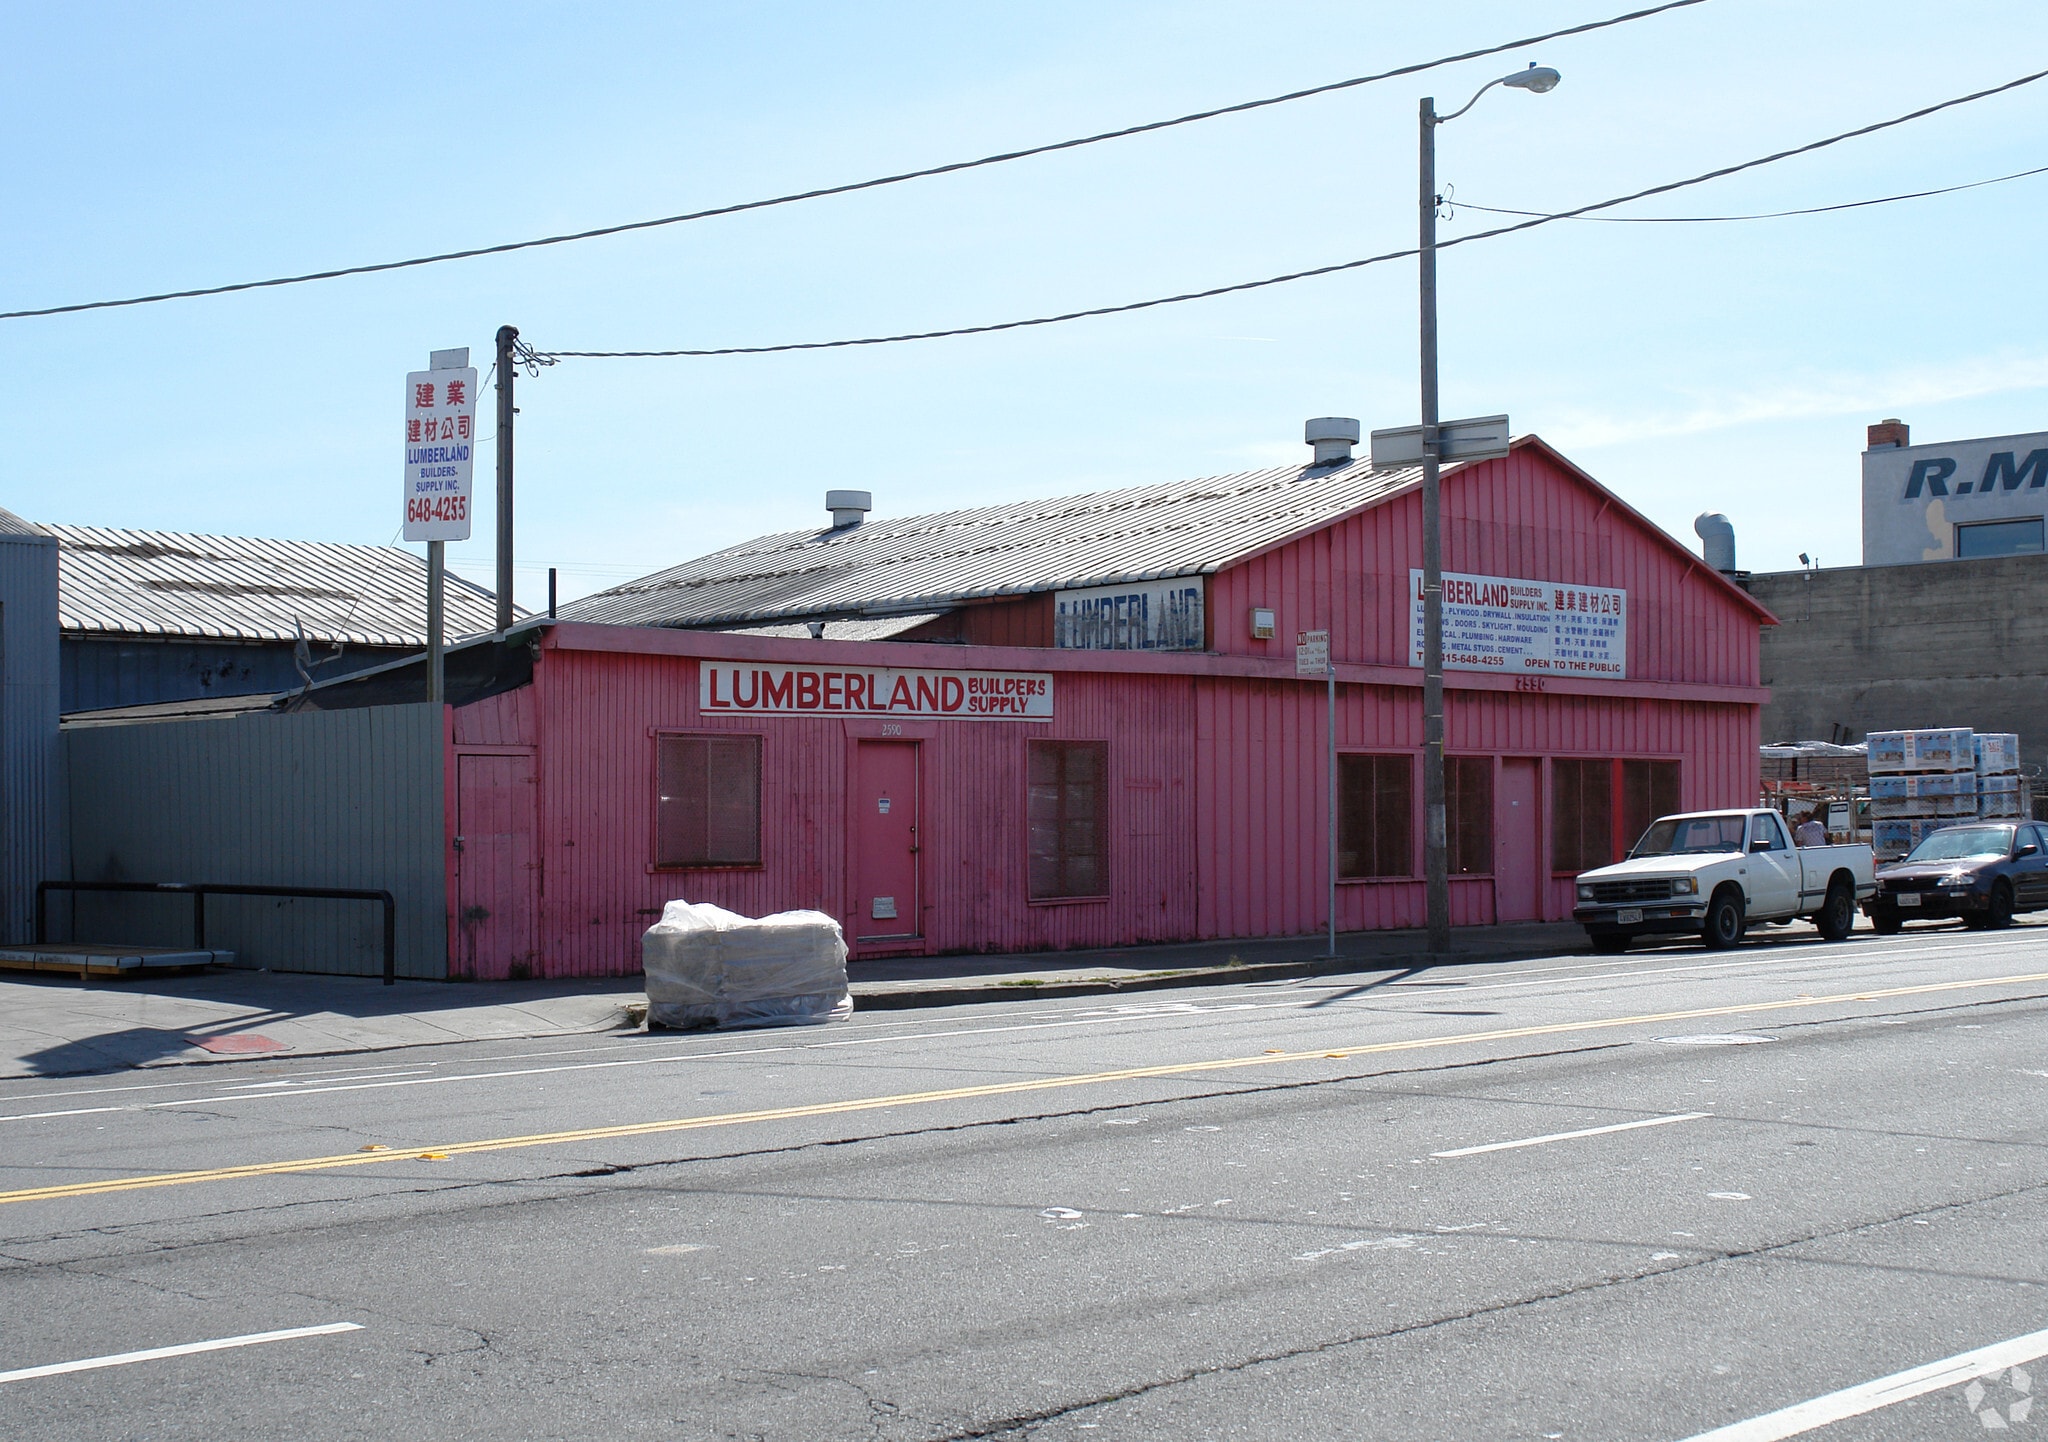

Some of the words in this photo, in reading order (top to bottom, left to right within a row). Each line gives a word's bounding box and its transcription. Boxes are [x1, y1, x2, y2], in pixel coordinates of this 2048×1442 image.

[415, 380, 466, 408] 建業
[407, 415, 471, 443] 建材公司
[408, 445, 469, 464] LUMBERLAND
[416, 480, 444, 493] SUPPLY
[445, 480, 460, 492] INC.
[408, 496, 467, 523] 648-4255
[1417, 577, 1509, 608] LBERLAND
[1510, 585, 1542, 598] BUILDERS
[1510, 599, 1534, 610] SUPPLY
[1536, 602, 1550, 612] INC.
[1554, 589, 1622, 615] 建業建材公司
[1058, 588, 1198, 650] LUMBERLAND
[1448, 607, 1480, 617] PLYWOOD
[1483, 610, 1512, 619] DRYWALL
[1515, 613, 1551, 622] INSULATION
[1455, 620, 1477, 628] DOORS
[1481, 621, 1513, 631] SKYLIGHT
[1516, 624, 1549, 634] MOULDING
[1461, 632, 1494, 642] PLUMBING
[1498, 635, 1533, 644] HARDWARE
[1451, 643, 1472, 652] METAL
[1473, 644, 1494, 653] STUDS
[1525, 658, 1550, 668] OPEN
[1553, 660, 1566, 670] TO
[1569, 661, 1586, 671] THE
[1588, 663, 1621, 673] PUBLIC
[709, 669, 964, 712] LUMBERLAND
[968, 676, 1046, 696] BUILDERS
[968, 696, 1029, 714] SUPPLY
[881, 724, 902, 736] 2590
